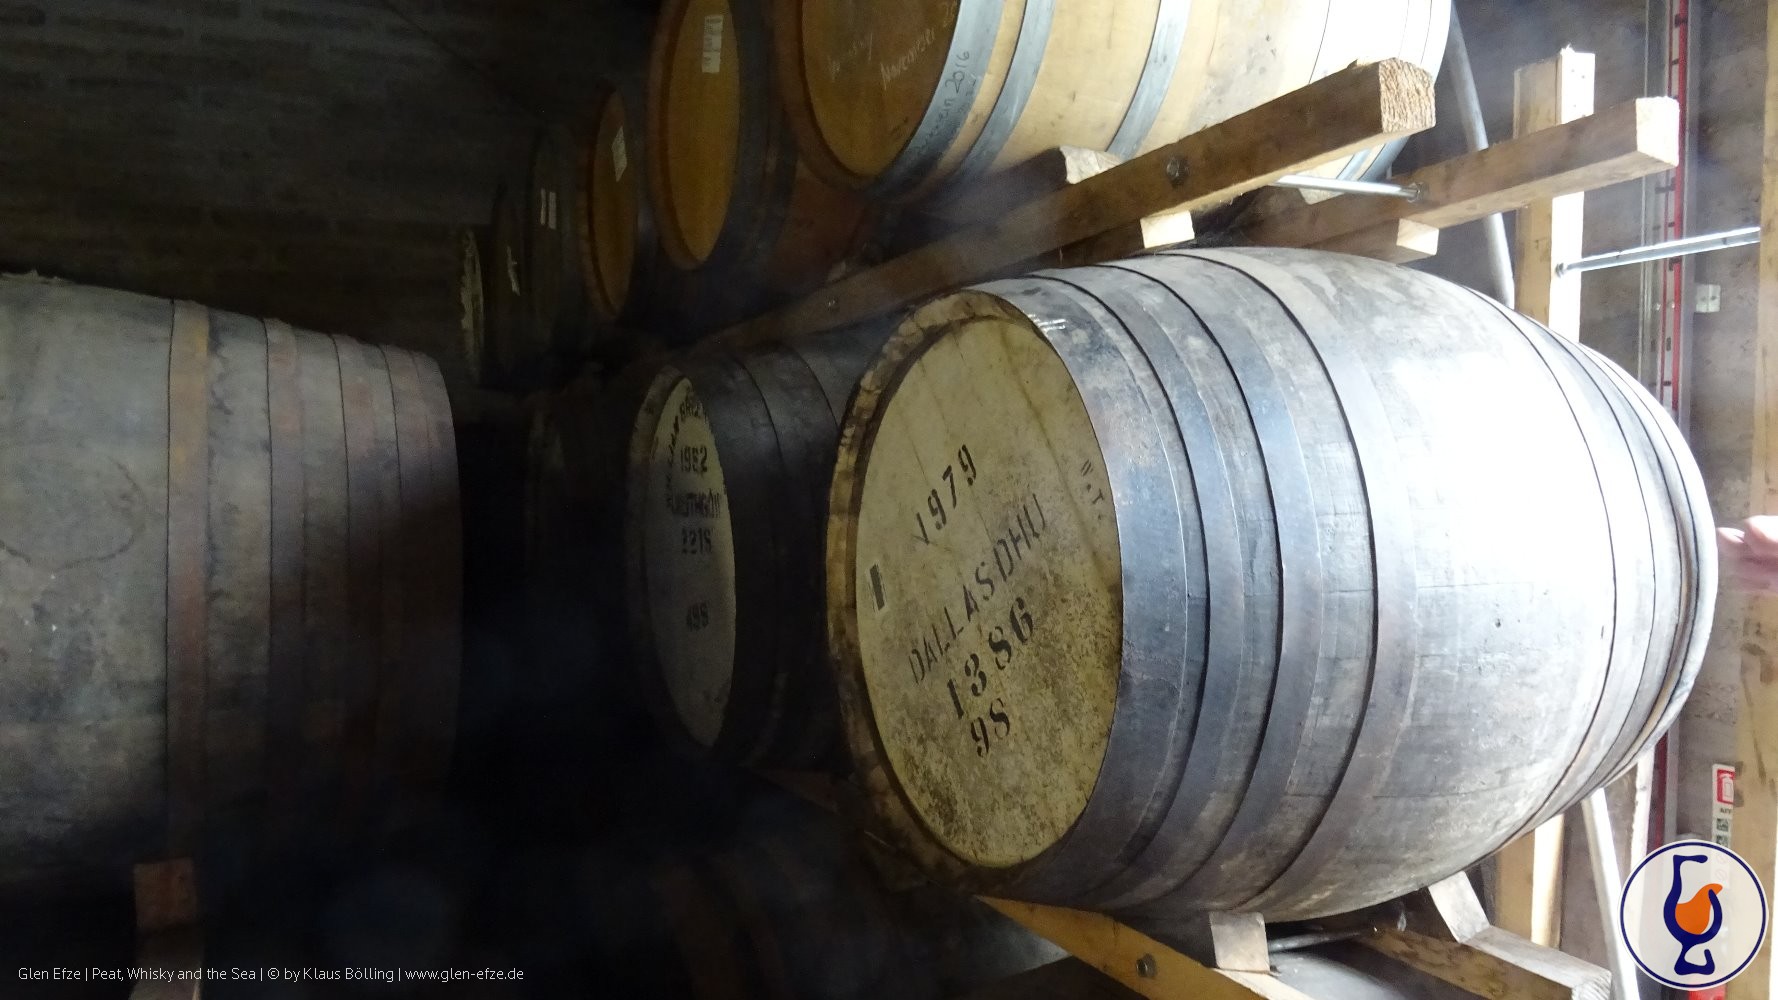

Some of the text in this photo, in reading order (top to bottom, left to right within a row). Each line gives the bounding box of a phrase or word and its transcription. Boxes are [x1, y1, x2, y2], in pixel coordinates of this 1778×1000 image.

[944, 50, 970, 94] 2016
[914, 444, 977, 545] 1979
[947, 597, 1034, 720] 1386
